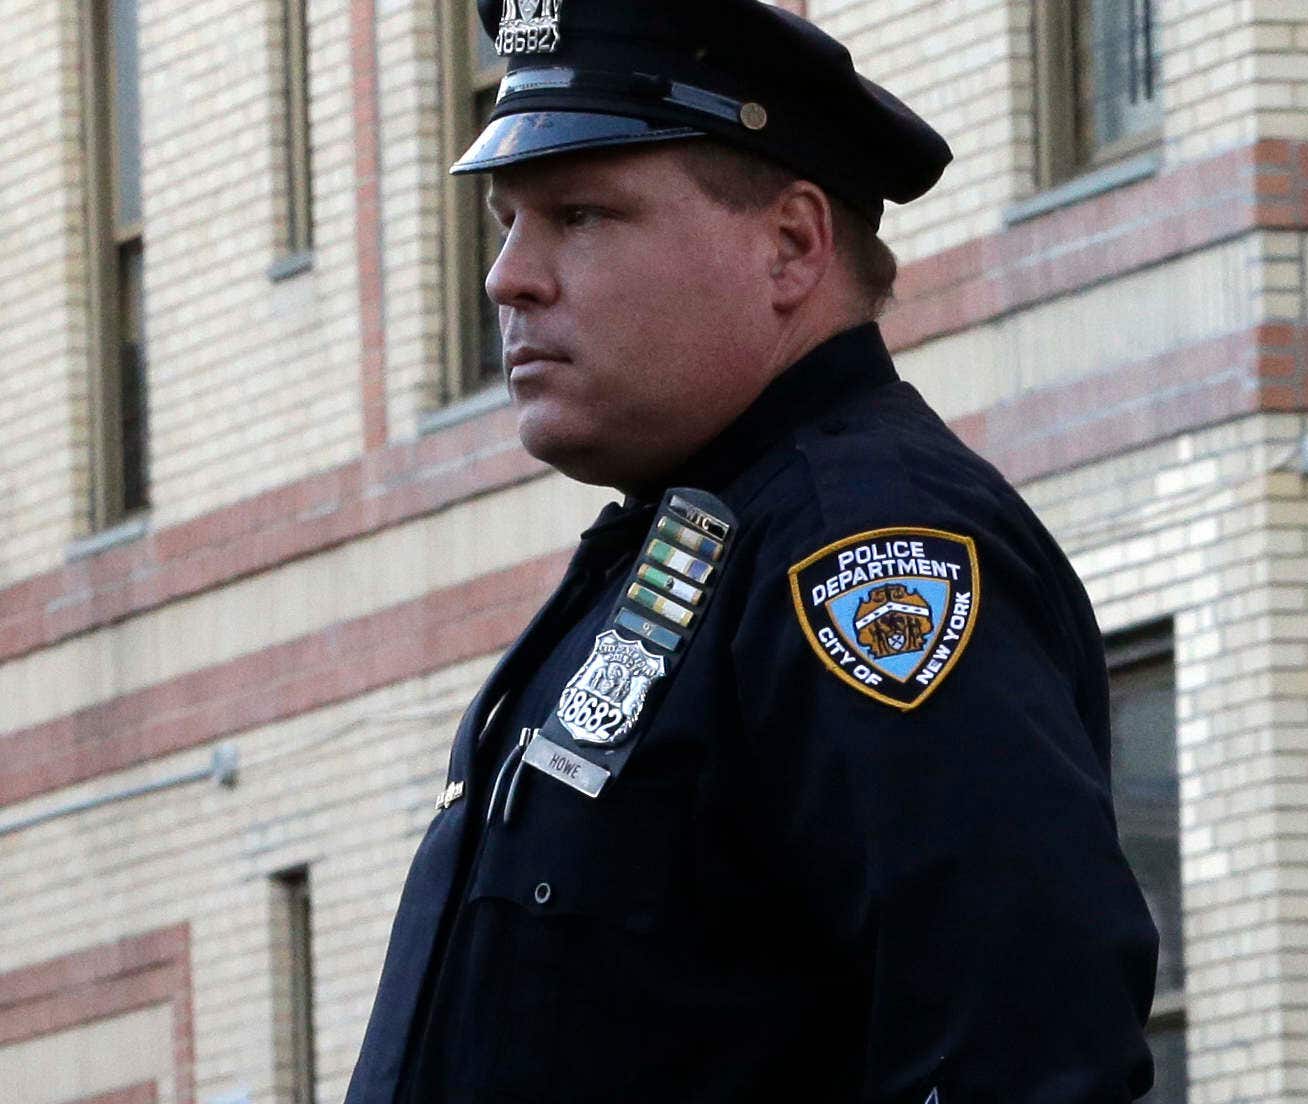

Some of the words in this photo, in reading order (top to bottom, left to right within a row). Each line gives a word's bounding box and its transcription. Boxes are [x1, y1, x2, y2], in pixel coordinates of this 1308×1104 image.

[498, 26, 551, 54] 18682
[837, 541, 926, 571] POLICE
[812, 558, 961, 607] DEPARTMENT
[817, 627, 857, 666] CITY
[852, 664, 883, 686] OF
[915, 644, 952, 686] NEW
[943, 591, 972, 643] YORK
[557, 687, 622, 739] 18682
[550, 752, 582, 778] HOWE
